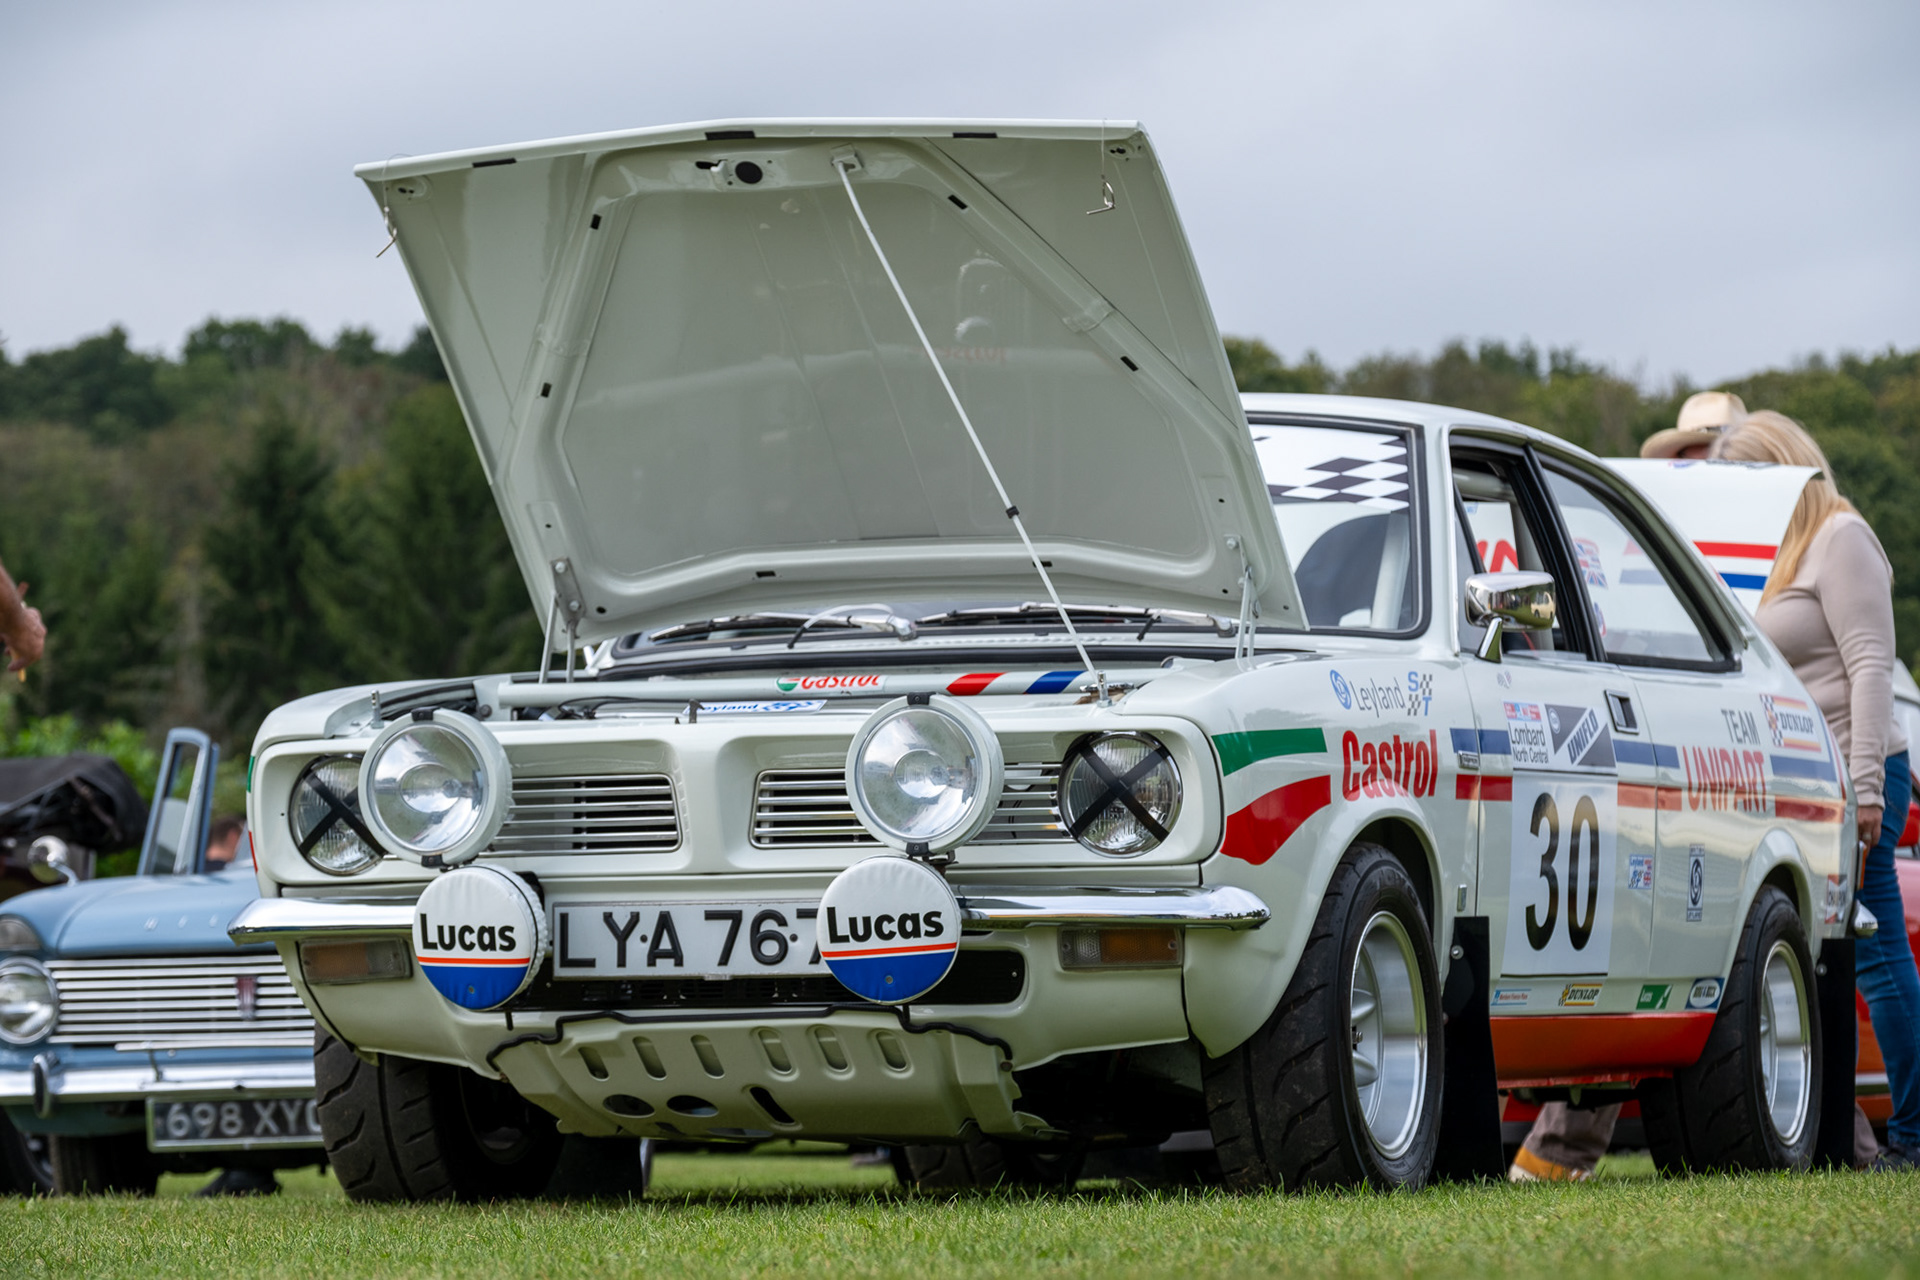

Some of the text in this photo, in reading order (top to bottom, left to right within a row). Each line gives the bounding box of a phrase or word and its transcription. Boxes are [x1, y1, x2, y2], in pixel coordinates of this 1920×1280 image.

[704, 704, 758, 712] eyland
[1350, 677, 1406, 718] Leyland
[1508, 722, 1546, 747] Lombard
[1567, 708, 1600, 765] UNIFLO
[1721, 709, 1761, 745] TEAM
[1780, 712, 1814, 734] DUNLOP
[1342, 729, 1438, 802] Castrol
[1513, 746, 1549, 764] North Central
[1682, 746, 1767, 812] UNIPART
[1525, 792, 1600, 952] 30
[419, 913, 517, 952] Lucas
[559, 911, 684, 968] LYA
[827, 906, 944, 944] Lucas
[1567, 988, 1599, 1001] DUNLOP
[166, 1102, 244, 1138] 698
